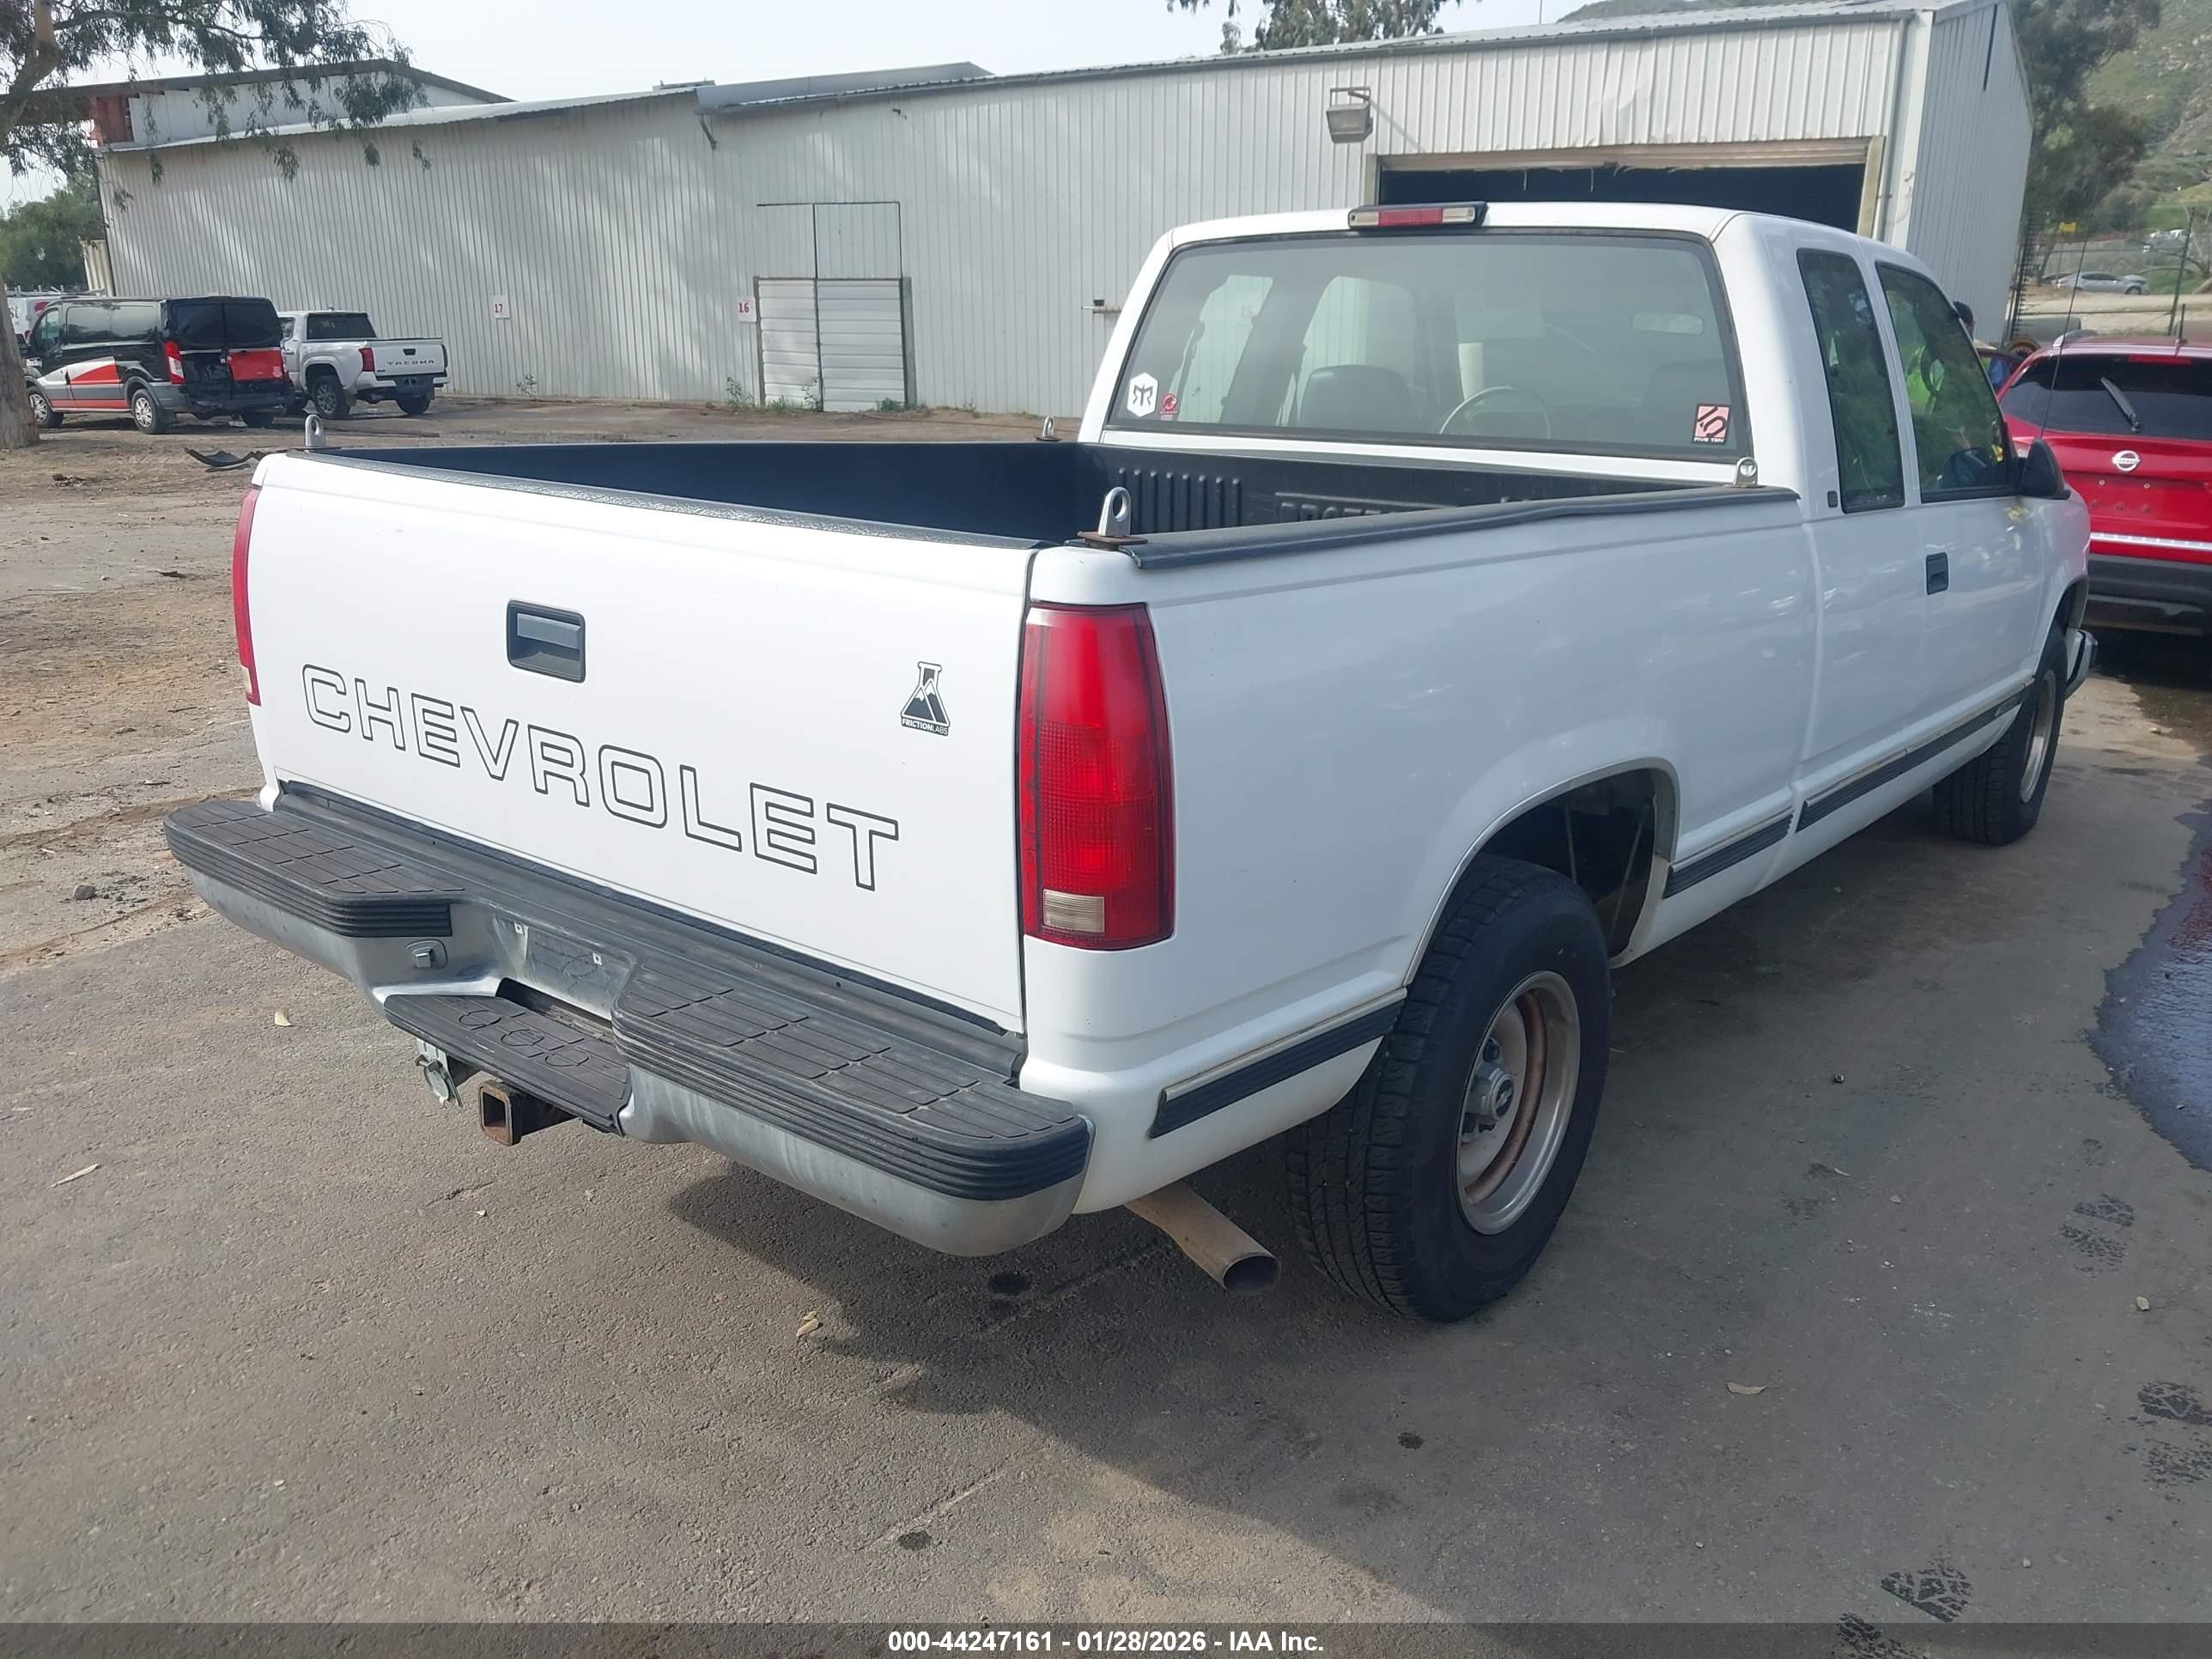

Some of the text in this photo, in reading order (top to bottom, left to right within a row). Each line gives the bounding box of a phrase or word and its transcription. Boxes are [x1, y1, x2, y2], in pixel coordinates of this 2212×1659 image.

[495, 303, 503, 313] 17
[738, 302, 750, 313] 16
[902, 718, 948, 735] FRICTIONLABS
[302, 664, 899, 891] CHEVROLET
